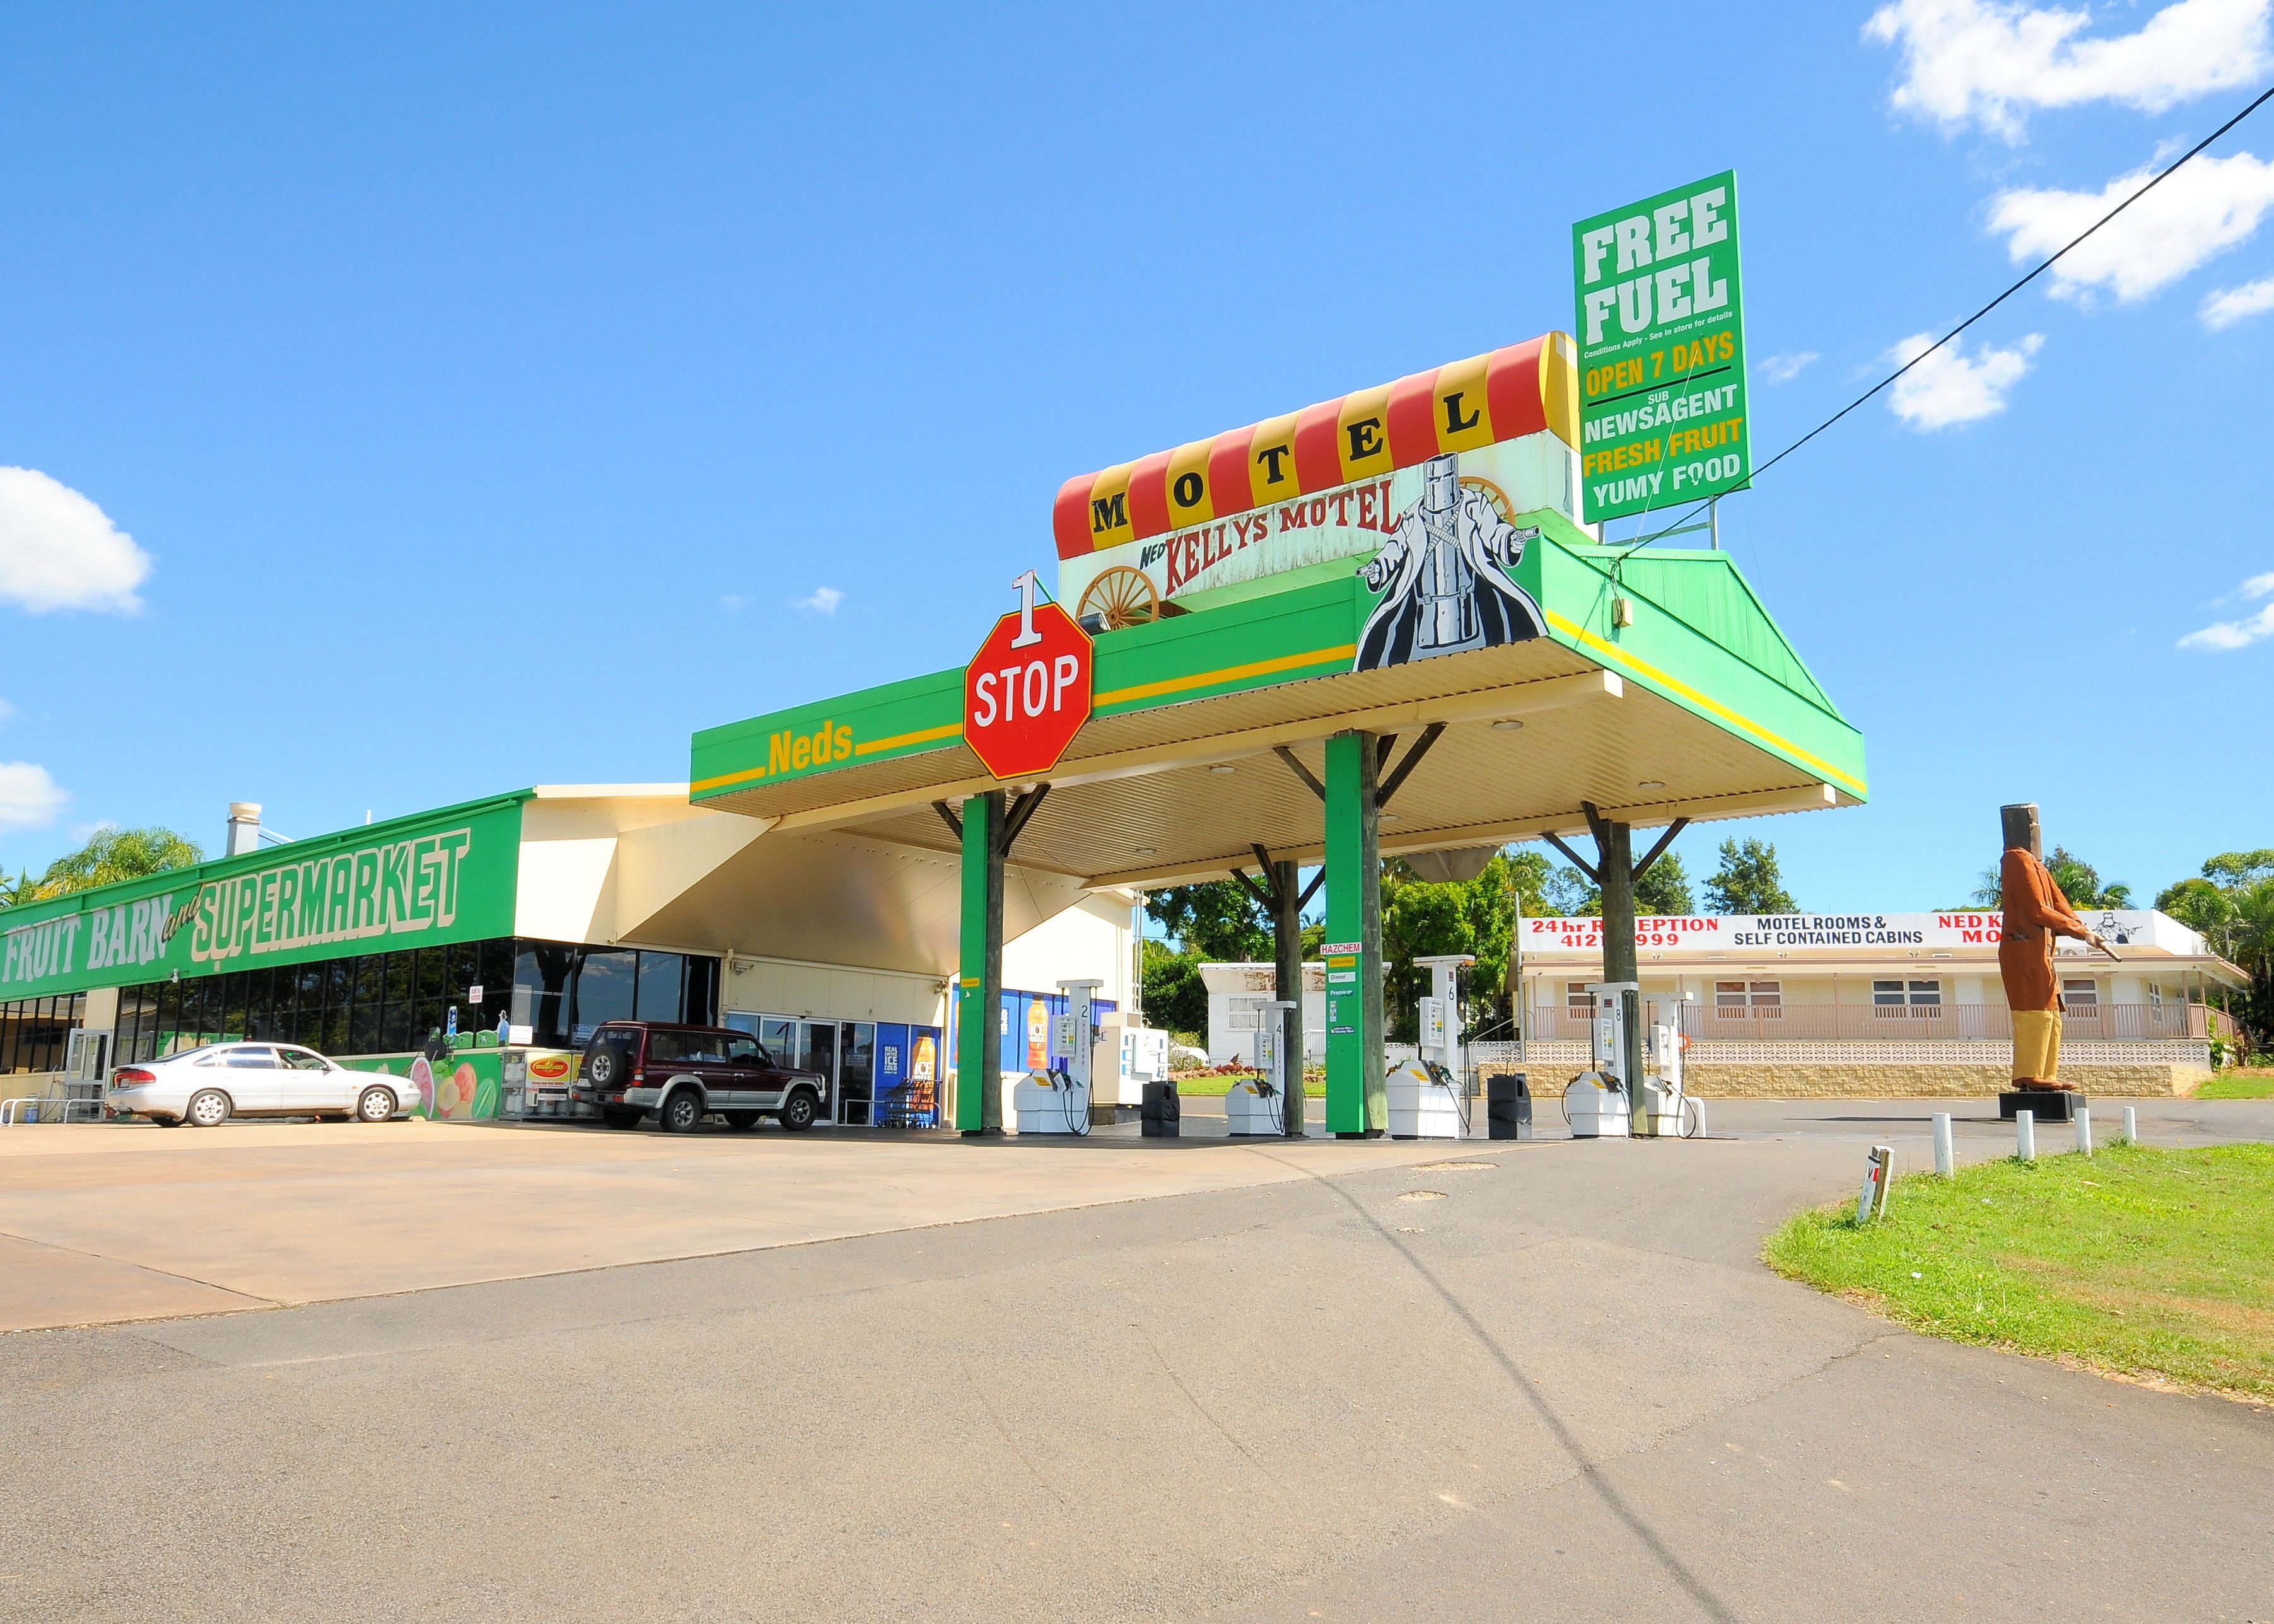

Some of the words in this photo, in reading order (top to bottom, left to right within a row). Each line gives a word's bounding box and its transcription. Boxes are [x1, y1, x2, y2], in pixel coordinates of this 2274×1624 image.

[1582, 186, 1728, 285] FREE
[1584, 256, 1728, 346] FUEL
[1584, 343, 1621, 359] Conditions
[1623, 337, 1643, 349] Apply
[1649, 332, 1662, 340] See
[1674, 324, 1693, 334] store
[1694, 320, 1705, 328] for
[1707, 311, 1733, 324] details
[1586, 357, 1643, 397] OPEN
[1651, 351, 1665, 378] 7
[1673, 331, 1734, 373] DAYS
[1648, 390, 1669, 405] SUB
[1585, 383, 1737, 444] NEWSAGENT
[1090, 390, 1481, 535] MOTEL
[1583, 438, 1661, 477] FRESH
[1669, 417, 1743, 457] FRUIT
[1593, 471, 1664, 508] YUMY
[1672, 453, 1740, 490] FOOD
[1140, 542, 1166, 571] NED
[1165, 511, 1268, 596] KELLYS
[1280, 480, 1402, 535] MOTEL
[1012, 569, 1042, 649] 1
[973, 654, 1079, 728] STOP
[769, 720, 853, 776] Neds
[1, 914, 81, 983] FRUIT
[86, 894, 173, 970] BARN
[161, 882, 206, 944] and
[191, 827, 472, 962] SUPERMARKET
[1532, 920, 1585, 933] 24hr
[1591, 918, 1719, 932] REPTION
[1757, 917, 1811, 931] MOTEL
[1814, 916, 1871, 930] ROOMS
[1875, 916, 1887, 929] &
[1938, 915, 1982, 929] NED
[1322, 943, 1360, 954] HAZCHEM
[1734, 932, 1773, 945] SELF
[1776, 931, 1862, 944] CONTAINED
[1865, 931, 1923, 944] CABINS
[1449, 986, 1454, 1001] 6
[1081, 1005, 1088, 1018] 2
[1616, 1009, 1621, 1021] 8
[1030, 1023, 1045, 1036] ICE
[1276, 1024, 1281, 1035] 4
[884, 1056, 898, 1065] ICE
[914, 1061, 933, 1075] ICE
